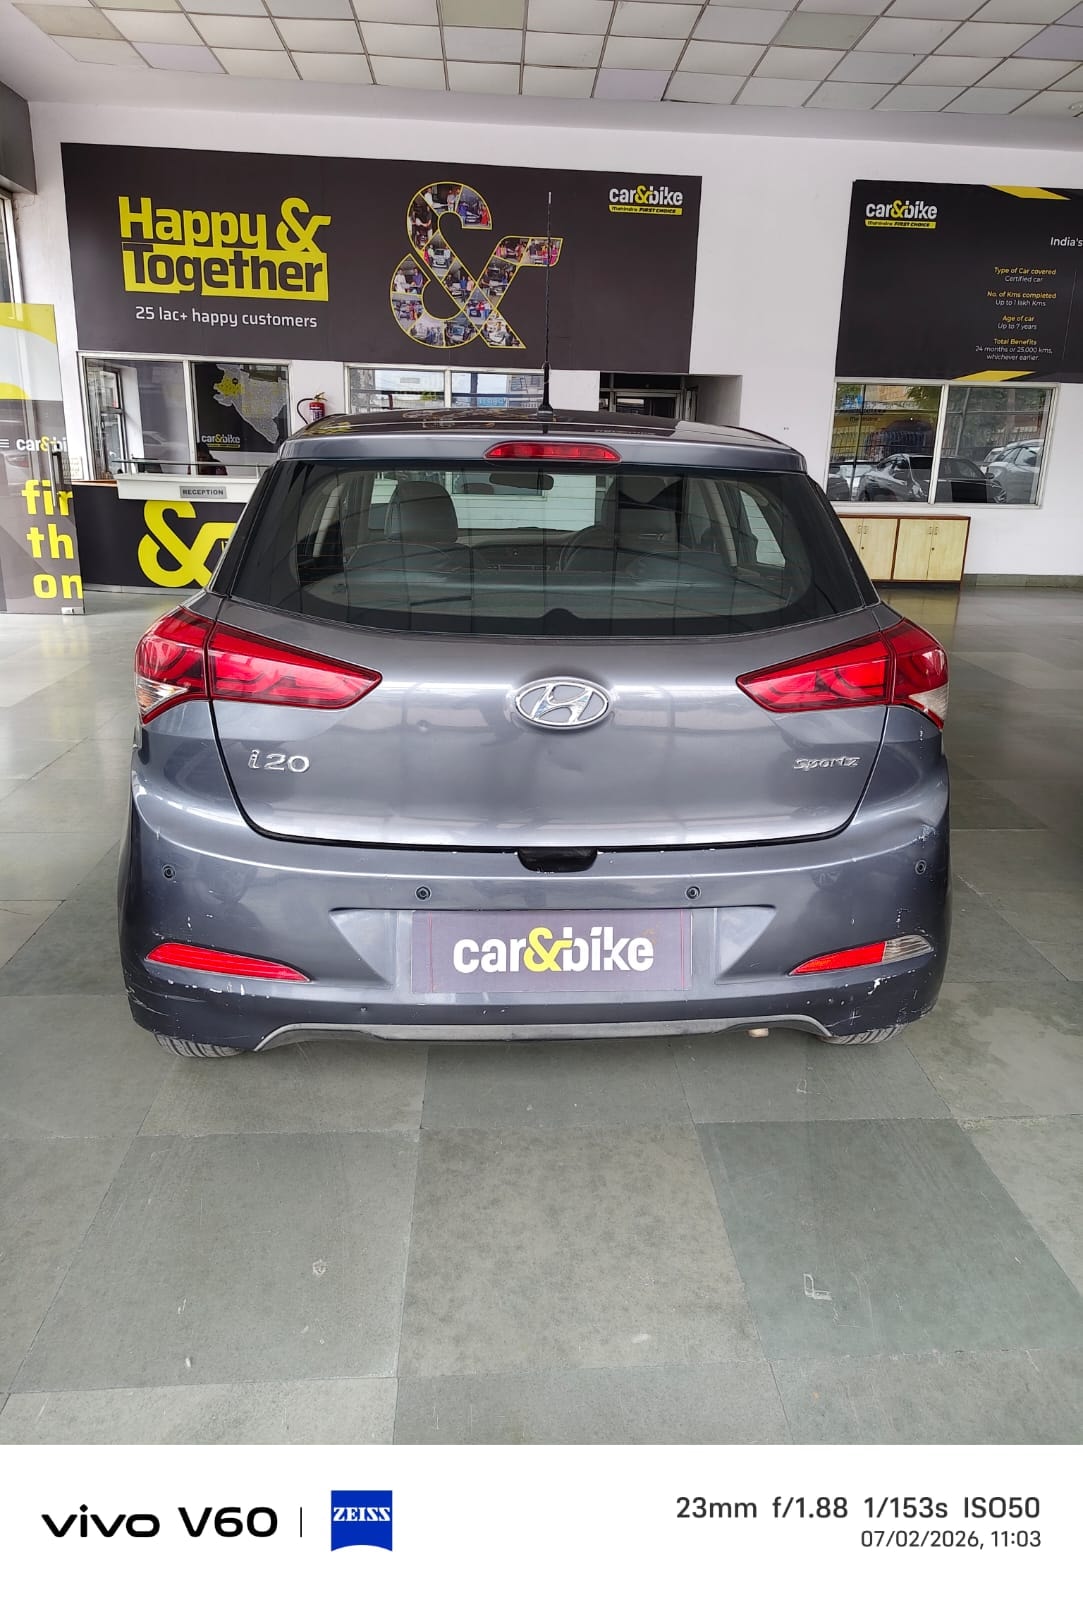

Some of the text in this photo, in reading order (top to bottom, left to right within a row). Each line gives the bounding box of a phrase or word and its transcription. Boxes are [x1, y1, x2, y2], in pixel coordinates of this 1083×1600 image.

[609, 185, 683, 205] car&bike
[865, 200, 938, 219] car&bike
[119, 196, 331, 253] Happy &
[1050, 236, 1083, 247] India's
[122, 243, 323, 297] Together
[994, 267, 1010, 275] Type
[995, 299, 1005, 307] Up
[135, 306, 318, 328] 25 lac+ happy customers
[21, 479, 74, 515] fir
[182, 488, 224, 496] RECEPTION
[26, 523, 74, 559] th
[248, 749, 310, 772] i20
[793, 756, 861, 771] Sportz
[453, 926, 654, 973] car&bike
